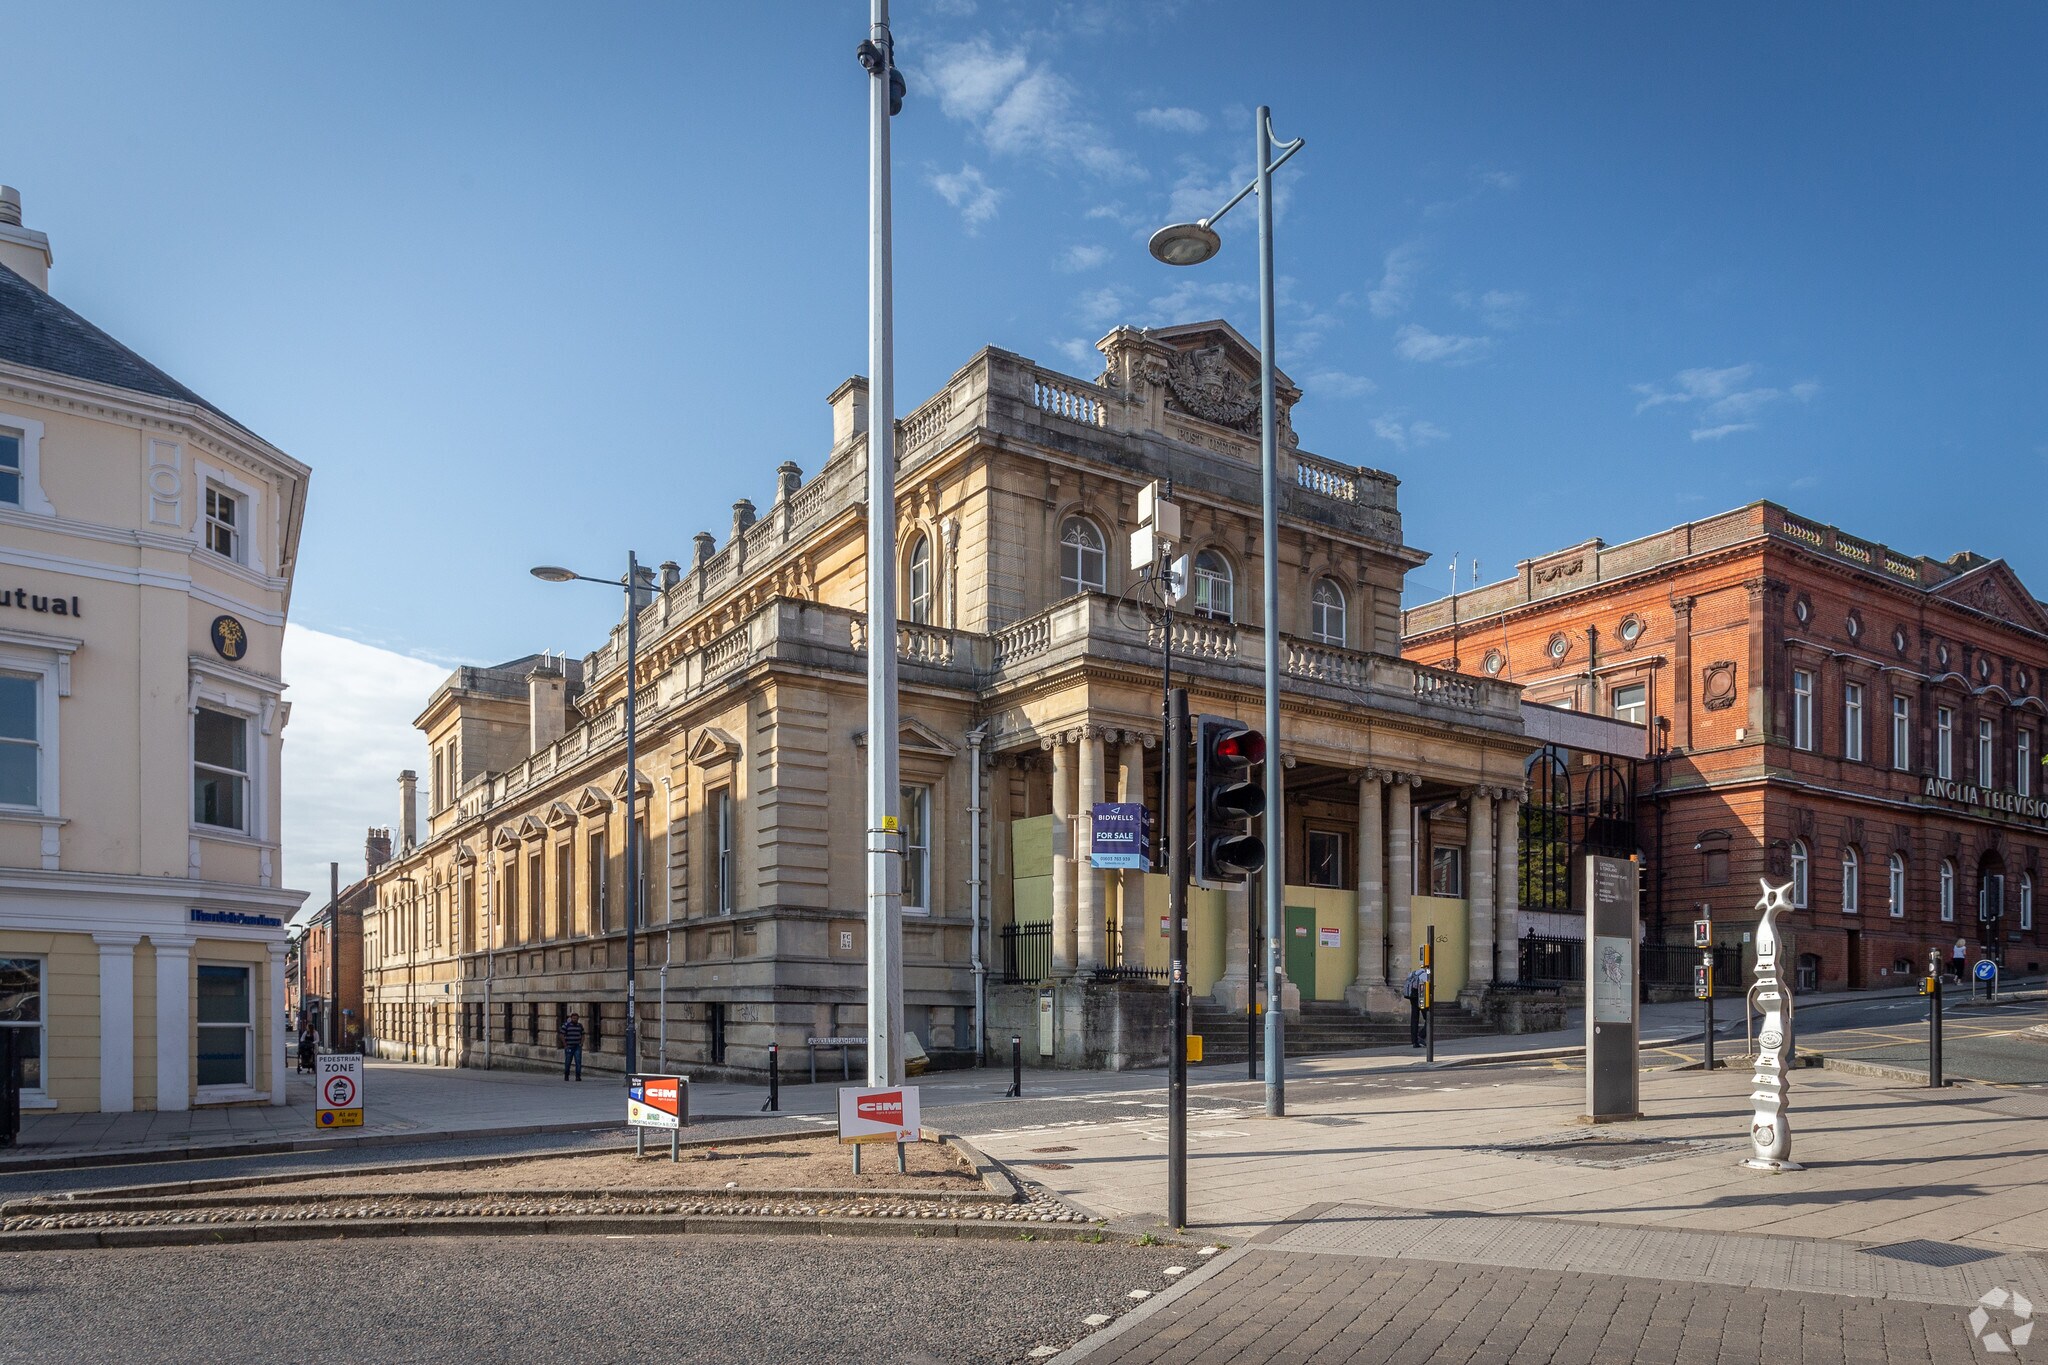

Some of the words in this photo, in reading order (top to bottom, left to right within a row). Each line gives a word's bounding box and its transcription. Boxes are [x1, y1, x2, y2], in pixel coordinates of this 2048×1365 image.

[1177, 428, 1204, 447] POST
[1208, 437, 1243, 459] OFFICE
[1925, 777, 1979, 805] ANGLIA
[325, 1064, 355, 1072] ZONE
